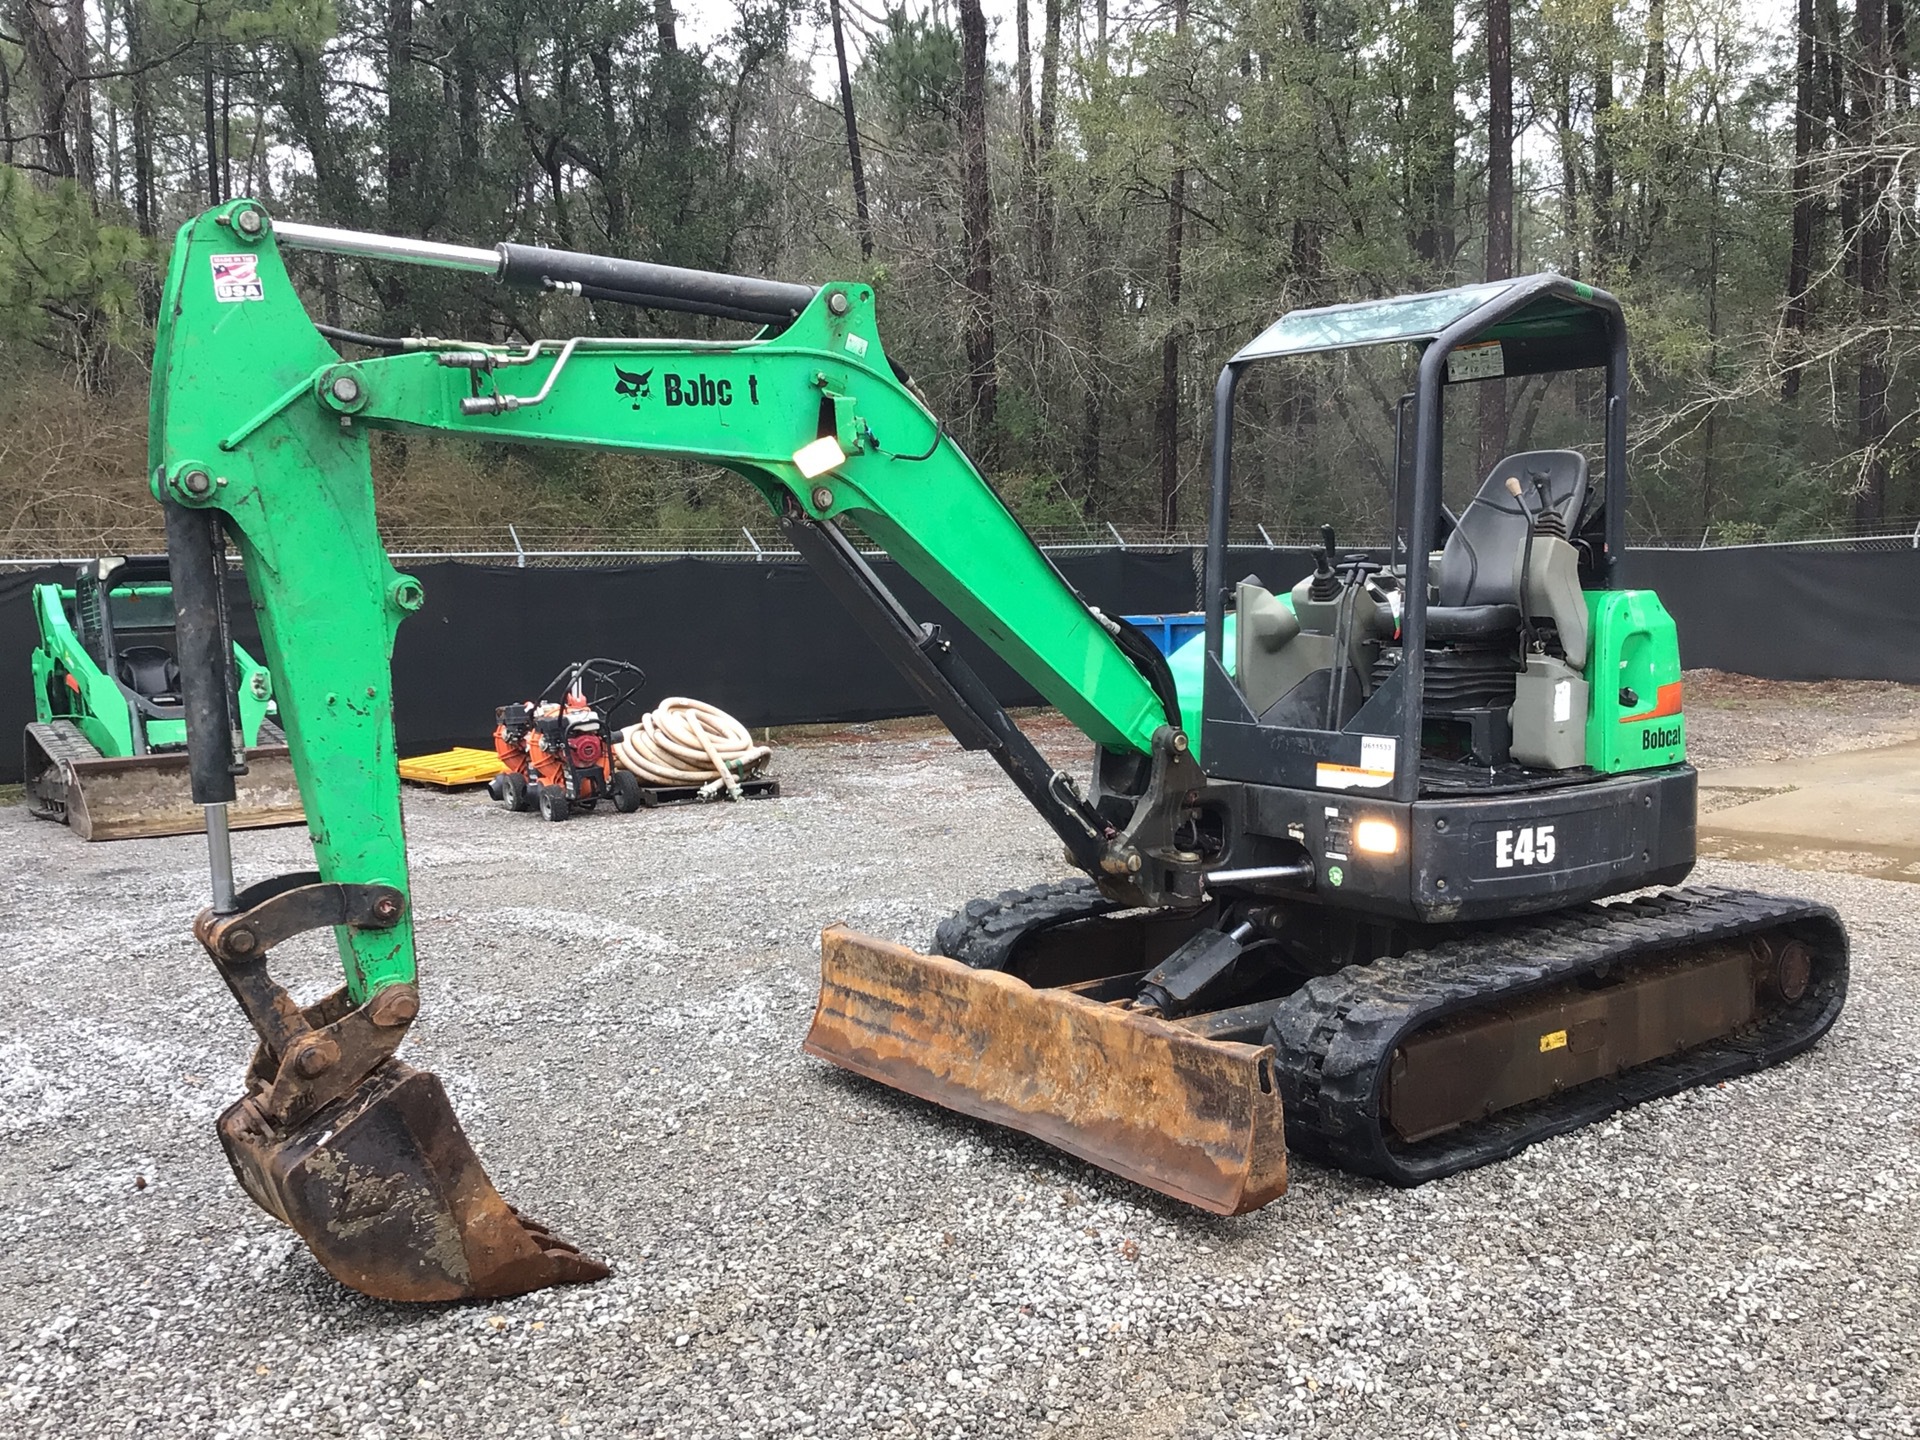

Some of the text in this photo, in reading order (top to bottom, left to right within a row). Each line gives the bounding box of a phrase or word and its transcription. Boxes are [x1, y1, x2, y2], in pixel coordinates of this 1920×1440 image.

[218, 285, 259, 297] USA
[664, 373, 759, 406] Bobct
[1496, 825, 1556, 868] E45
